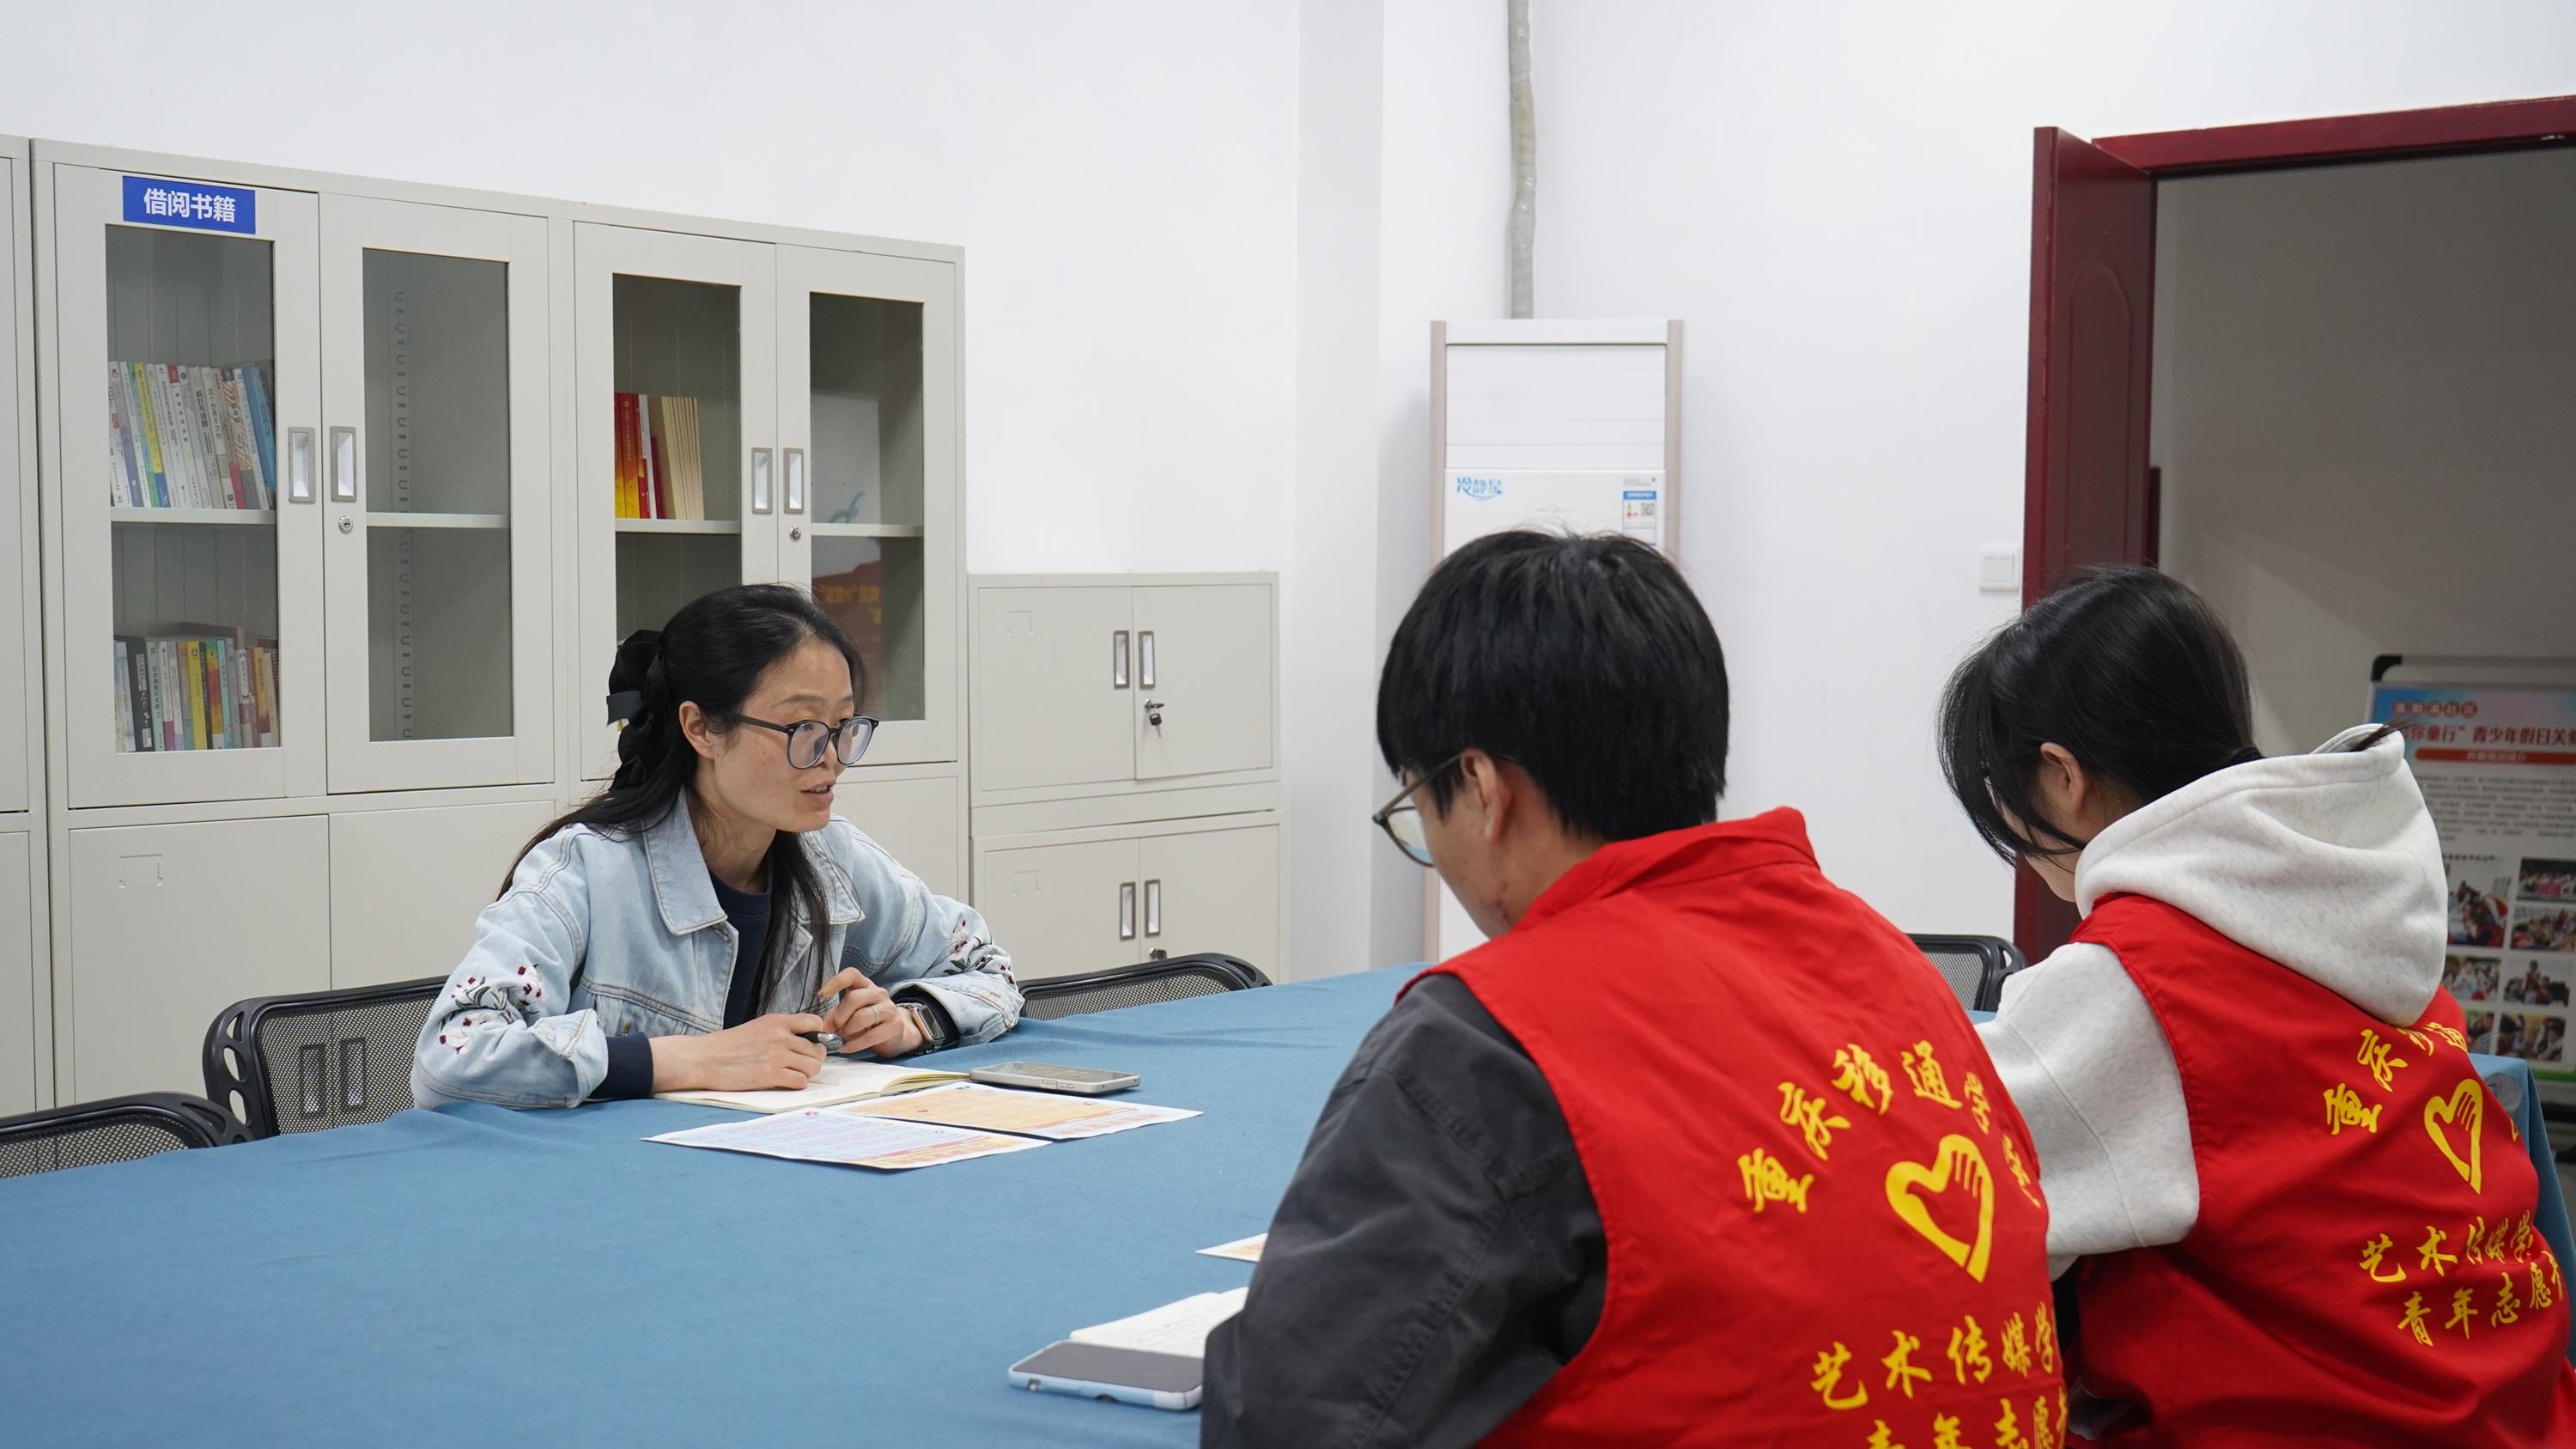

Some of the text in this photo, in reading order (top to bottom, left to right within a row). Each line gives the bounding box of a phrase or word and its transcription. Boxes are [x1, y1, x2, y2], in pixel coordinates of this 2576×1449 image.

[143, 187, 236, 223] 借阅书籍
[2359, 1209, 2535, 1282] 艺术传媒学
[1811, 1300, 2062, 1410] 艺术传媒学
